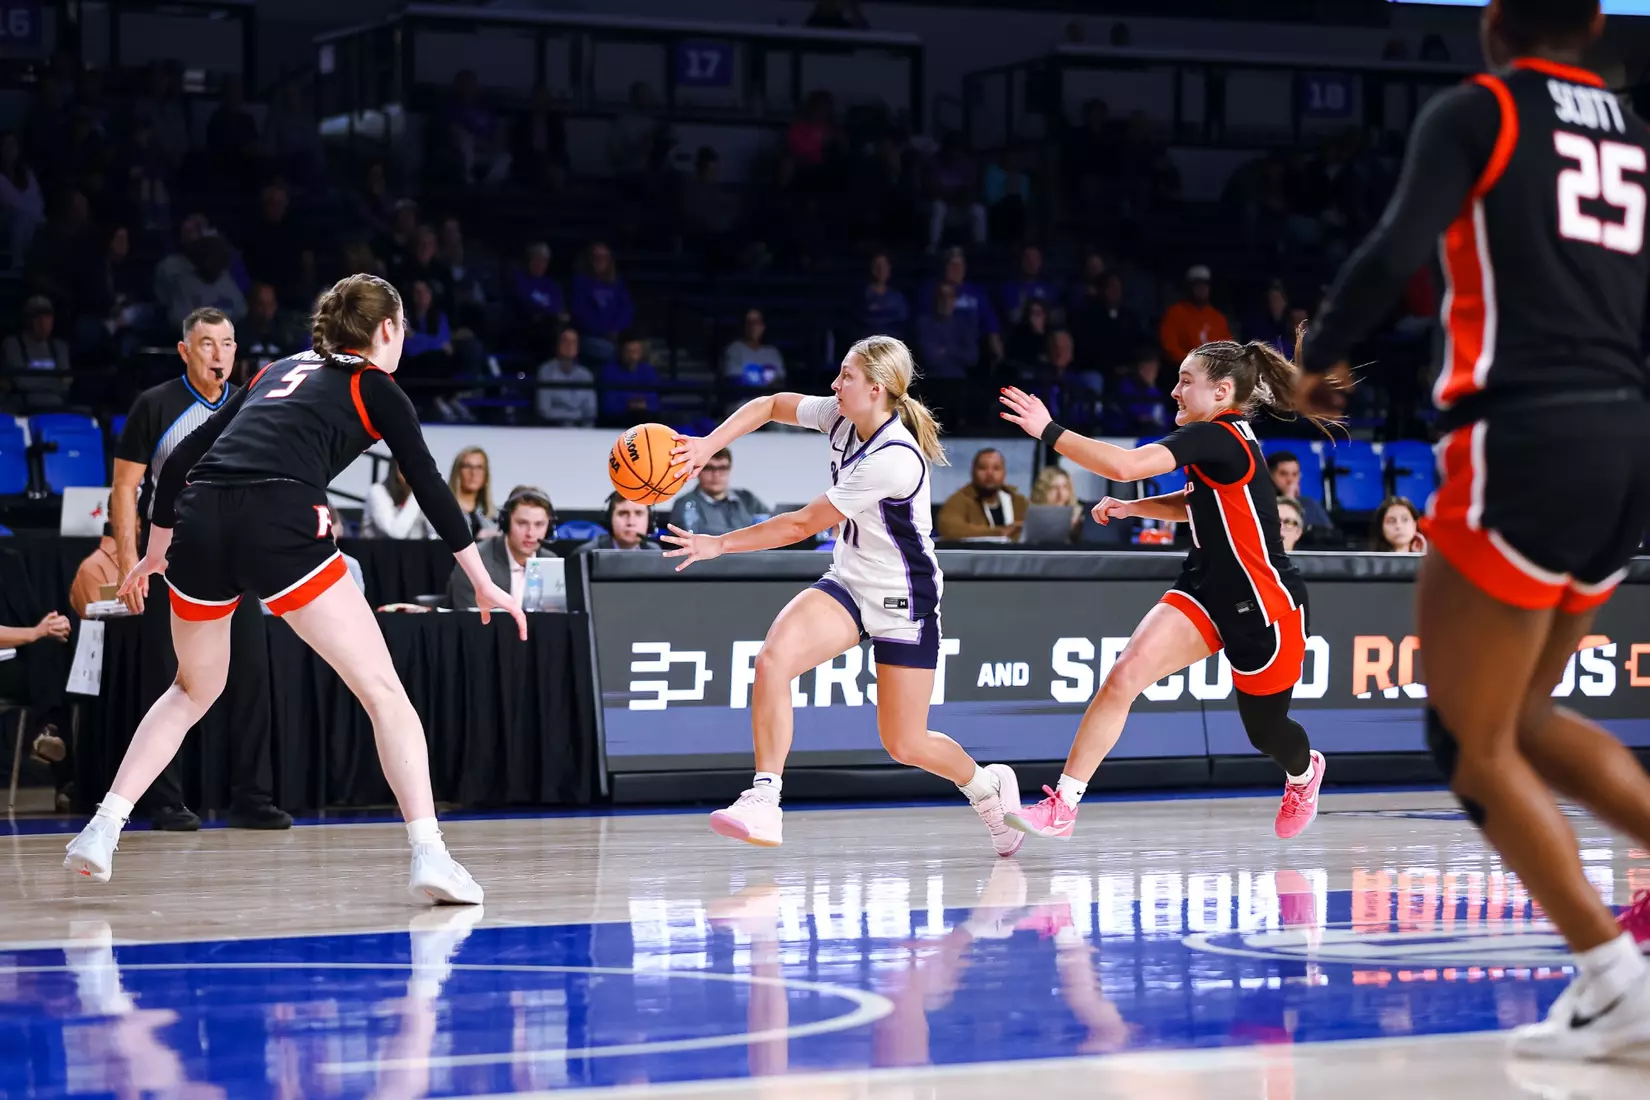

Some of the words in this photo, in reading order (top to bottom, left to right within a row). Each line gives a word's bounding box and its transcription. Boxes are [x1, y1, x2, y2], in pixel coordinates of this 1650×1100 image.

[685, 49, 722, 78] 17
[1546, 78, 1626, 134] SCOTT
[1553, 129, 1647, 255] 25
[264, 363, 324, 399] 5
[977, 662, 1030, 688] AND
